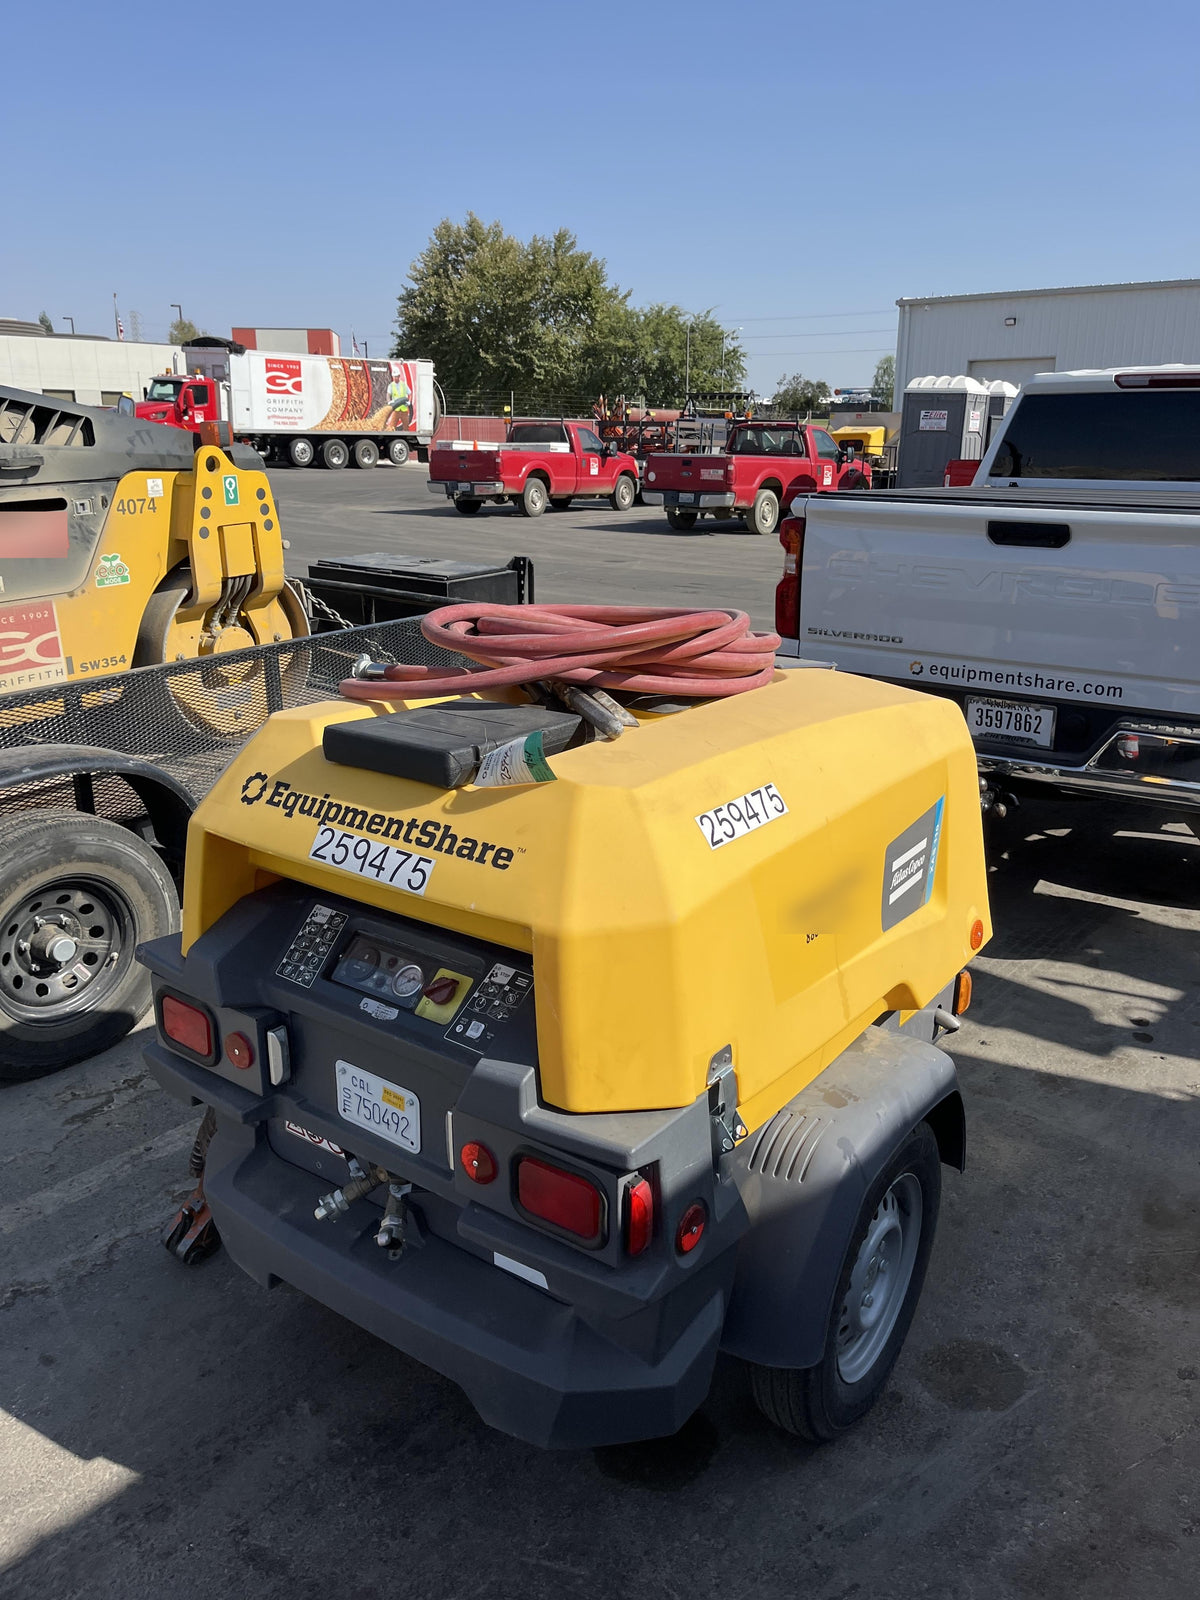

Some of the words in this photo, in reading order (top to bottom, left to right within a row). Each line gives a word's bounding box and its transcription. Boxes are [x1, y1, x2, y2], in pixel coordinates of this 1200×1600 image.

[116, 498, 157, 516] 4074
[98, 564, 125, 578] eco
[104, 576, 122, 586] MODE
[828, 556, 1200, 607] CHEVROLE
[22, 610, 49, 621] 1902
[807, 627, 904, 644] SILVERADO
[79, 654, 127, 673] SW354
[0, 668, 64, 689] RIFFITH
[929, 663, 1123, 699] equipmentshare.com
[975, 707, 1042, 735] 3597862
[266, 780, 515, 871] EquipmentShare
[699, 783, 786, 848] 259475
[311, 827, 432, 892] 259475
[889, 866, 909, 890] Atlas
[908, 854, 926, 875] Copco
[351, 1075, 373, 1096] CAL
[354, 1092, 410, 1141] 750492
